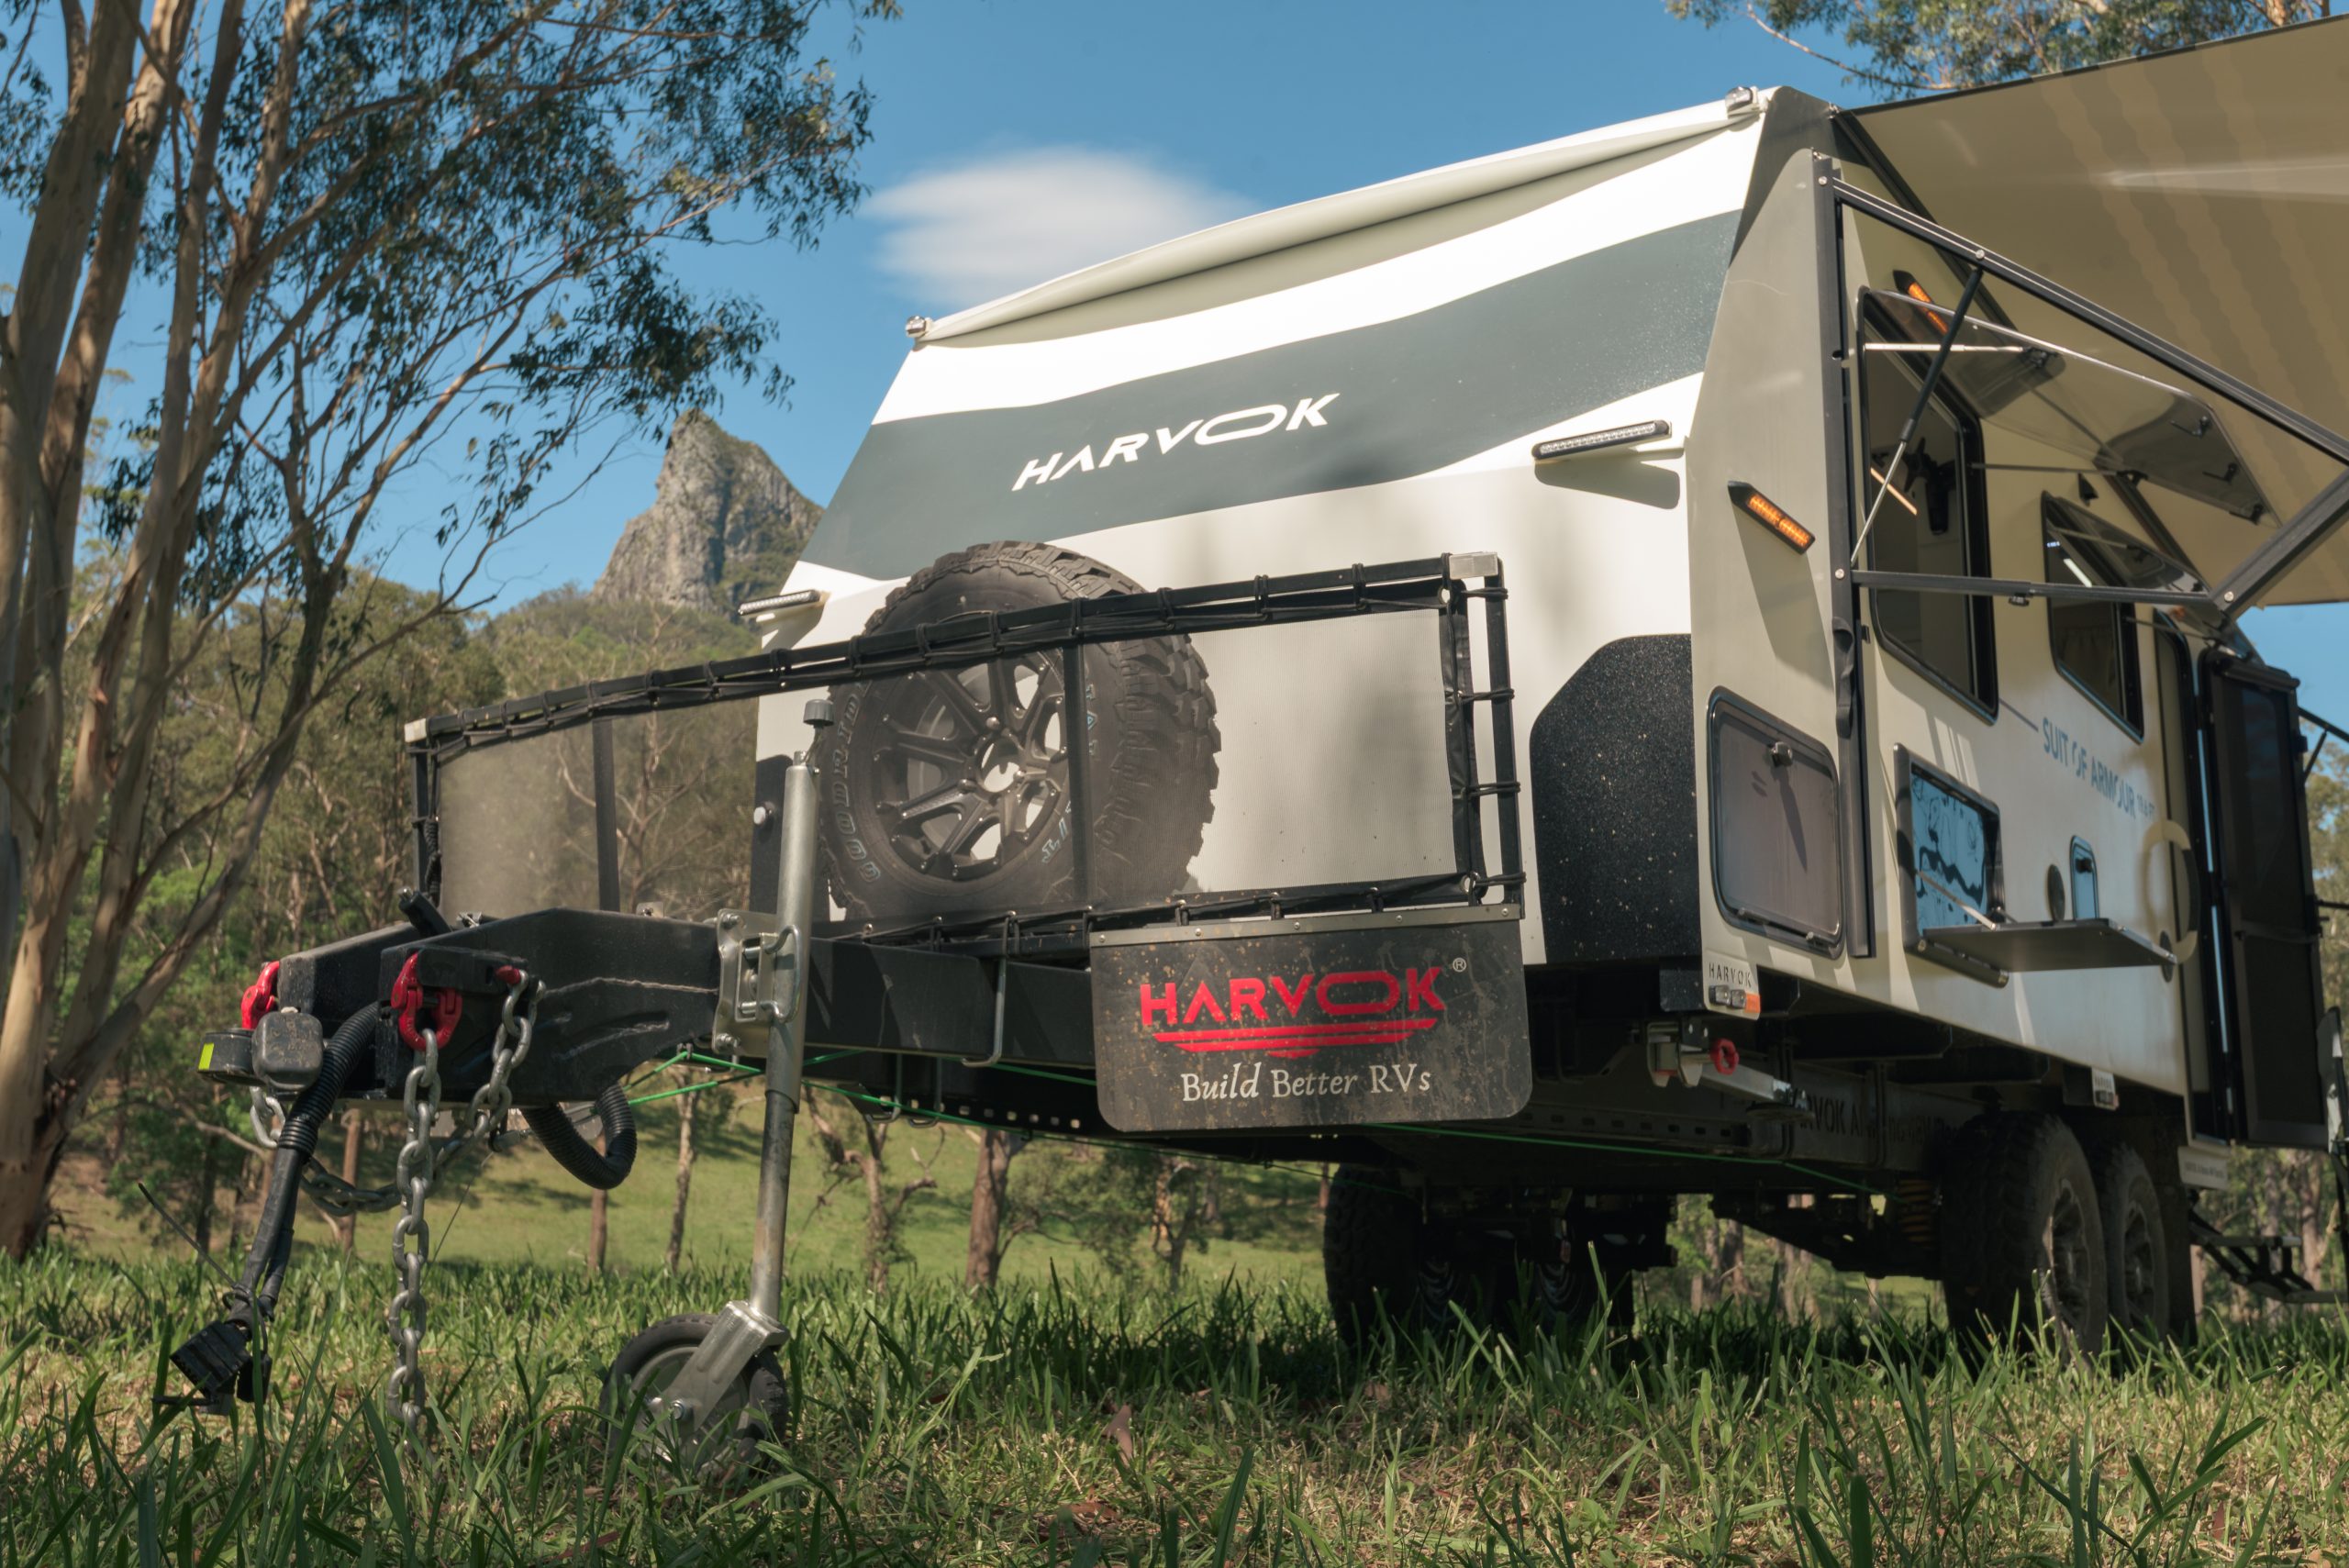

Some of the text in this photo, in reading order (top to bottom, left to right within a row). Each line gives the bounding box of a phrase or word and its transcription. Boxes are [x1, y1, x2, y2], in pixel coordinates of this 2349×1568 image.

[1011, 393, 1341, 491] HARVOK
[832, 680, 881, 883] GOODRID
[2043, 717, 2068, 767] SUIT
[2072, 740, 2087, 780] OF
[2090, 756, 2136, 818] ARMOUR
[1140, 966, 1447, 1026] HARVOK
[1709, 962, 1752, 988] HARVOK
[1180, 1062, 1432, 1102] Build Better RVs
